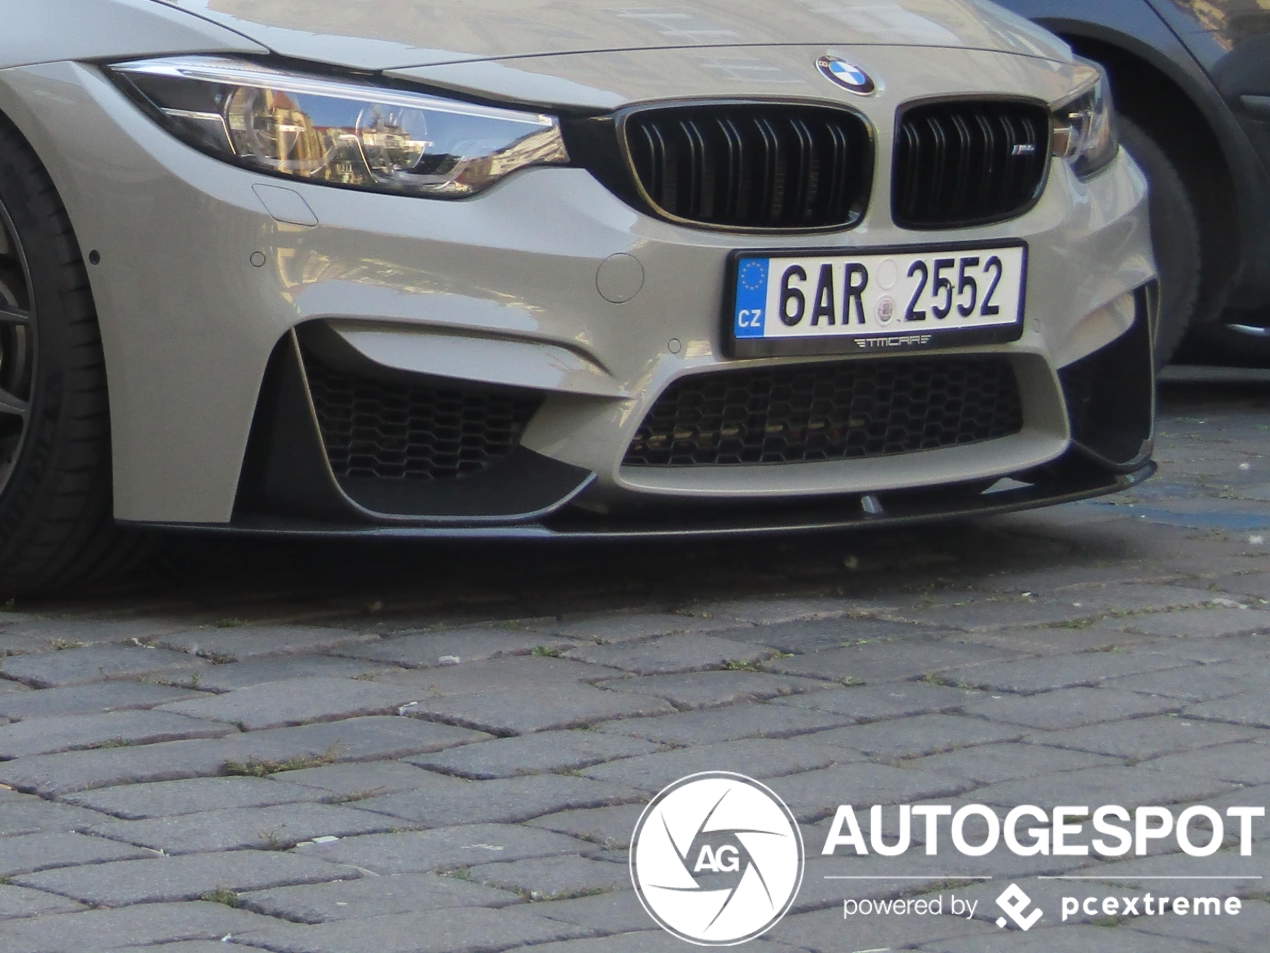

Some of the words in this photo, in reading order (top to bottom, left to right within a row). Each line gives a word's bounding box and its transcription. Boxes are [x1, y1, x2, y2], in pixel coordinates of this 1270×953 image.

[779, 262, 868, 327] 6AR
[904, 255, 1003, 322] 2552
[738, 309, 761, 328] CZ
